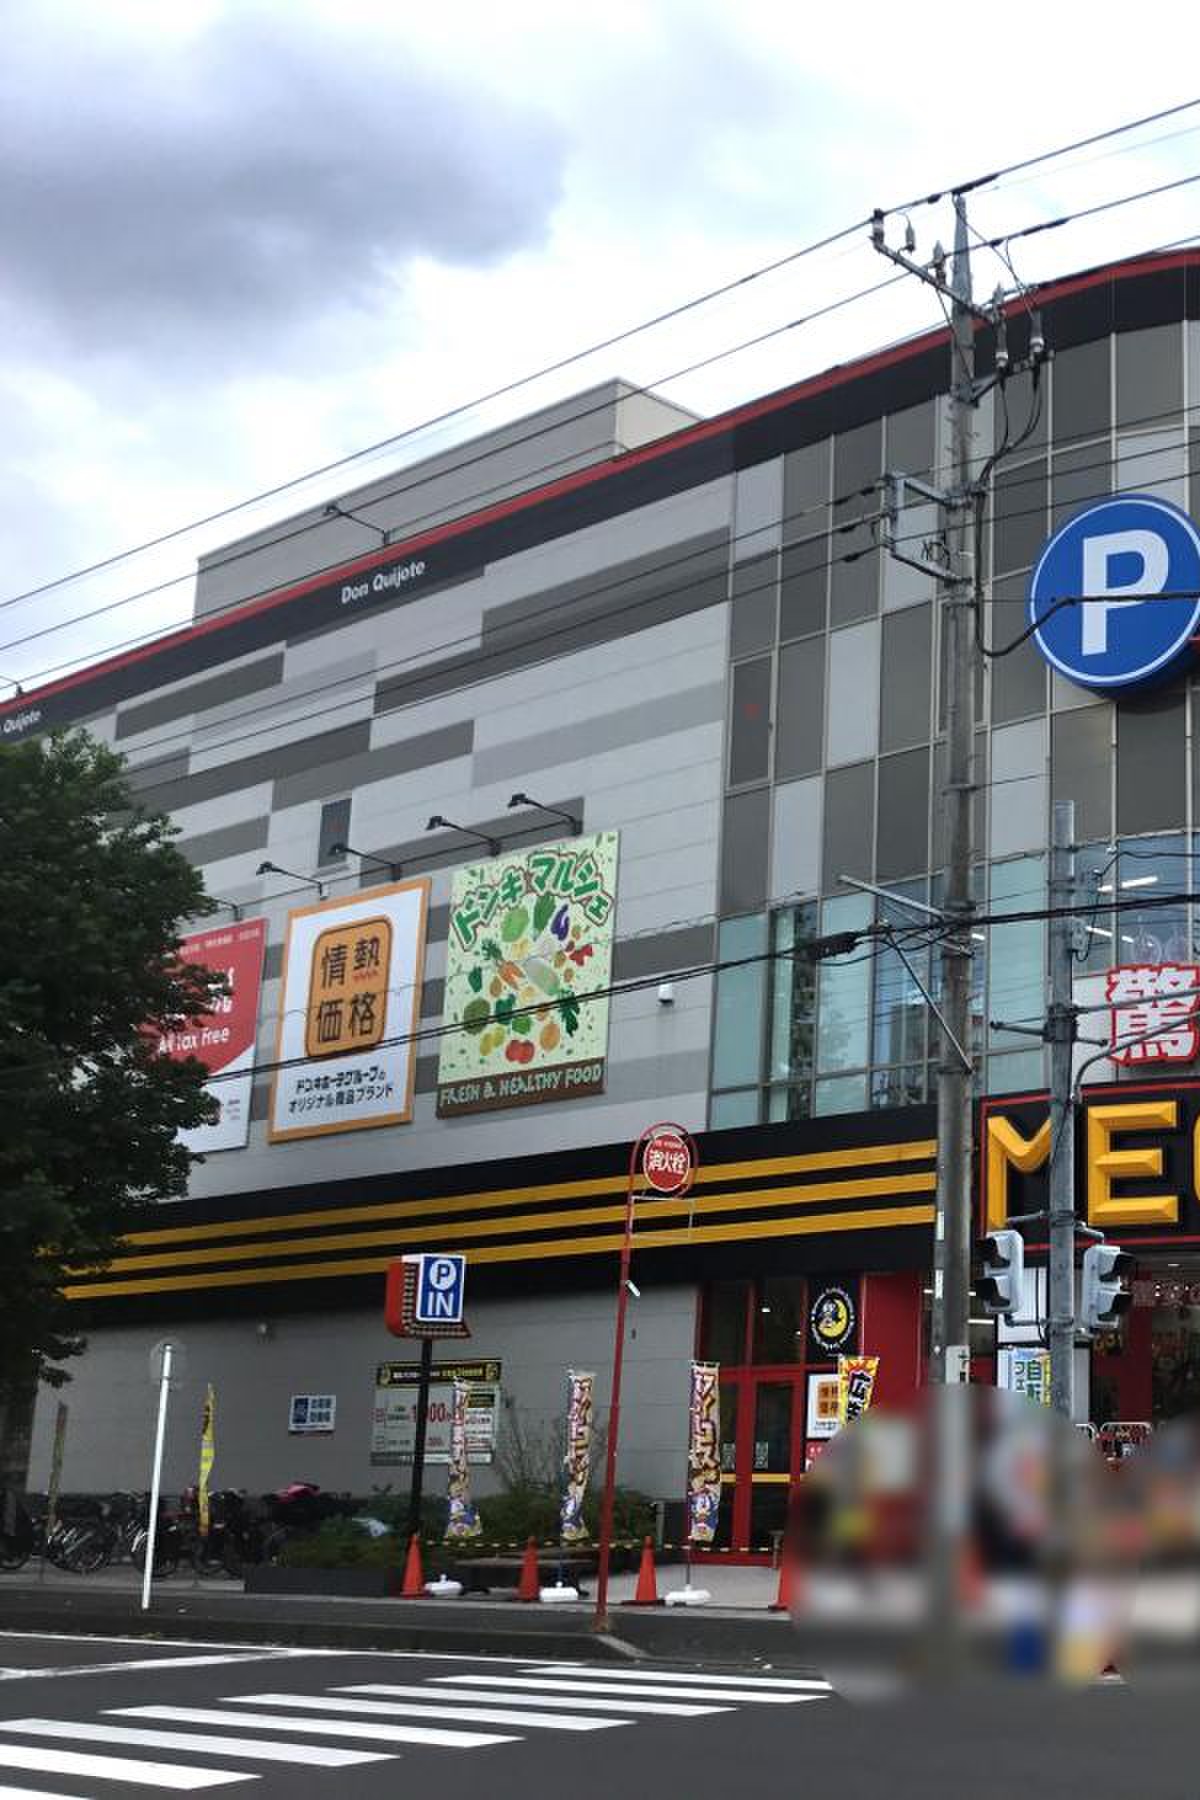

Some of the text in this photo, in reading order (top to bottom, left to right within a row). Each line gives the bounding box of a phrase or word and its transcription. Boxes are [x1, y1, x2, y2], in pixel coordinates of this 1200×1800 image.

[340, 560, 426, 605] Don Quijote
[1080, 527, 1170, 657] P
[321, 935, 380, 989] 情熱
[317, 991, 377, 1043] 価格
[498, 1071, 564, 1096] HEALTHY
[565, 1063, 602, 1088] FOOD
[435, 1263, 452, 1285] P
[427, 1292, 454, 1317] IN
